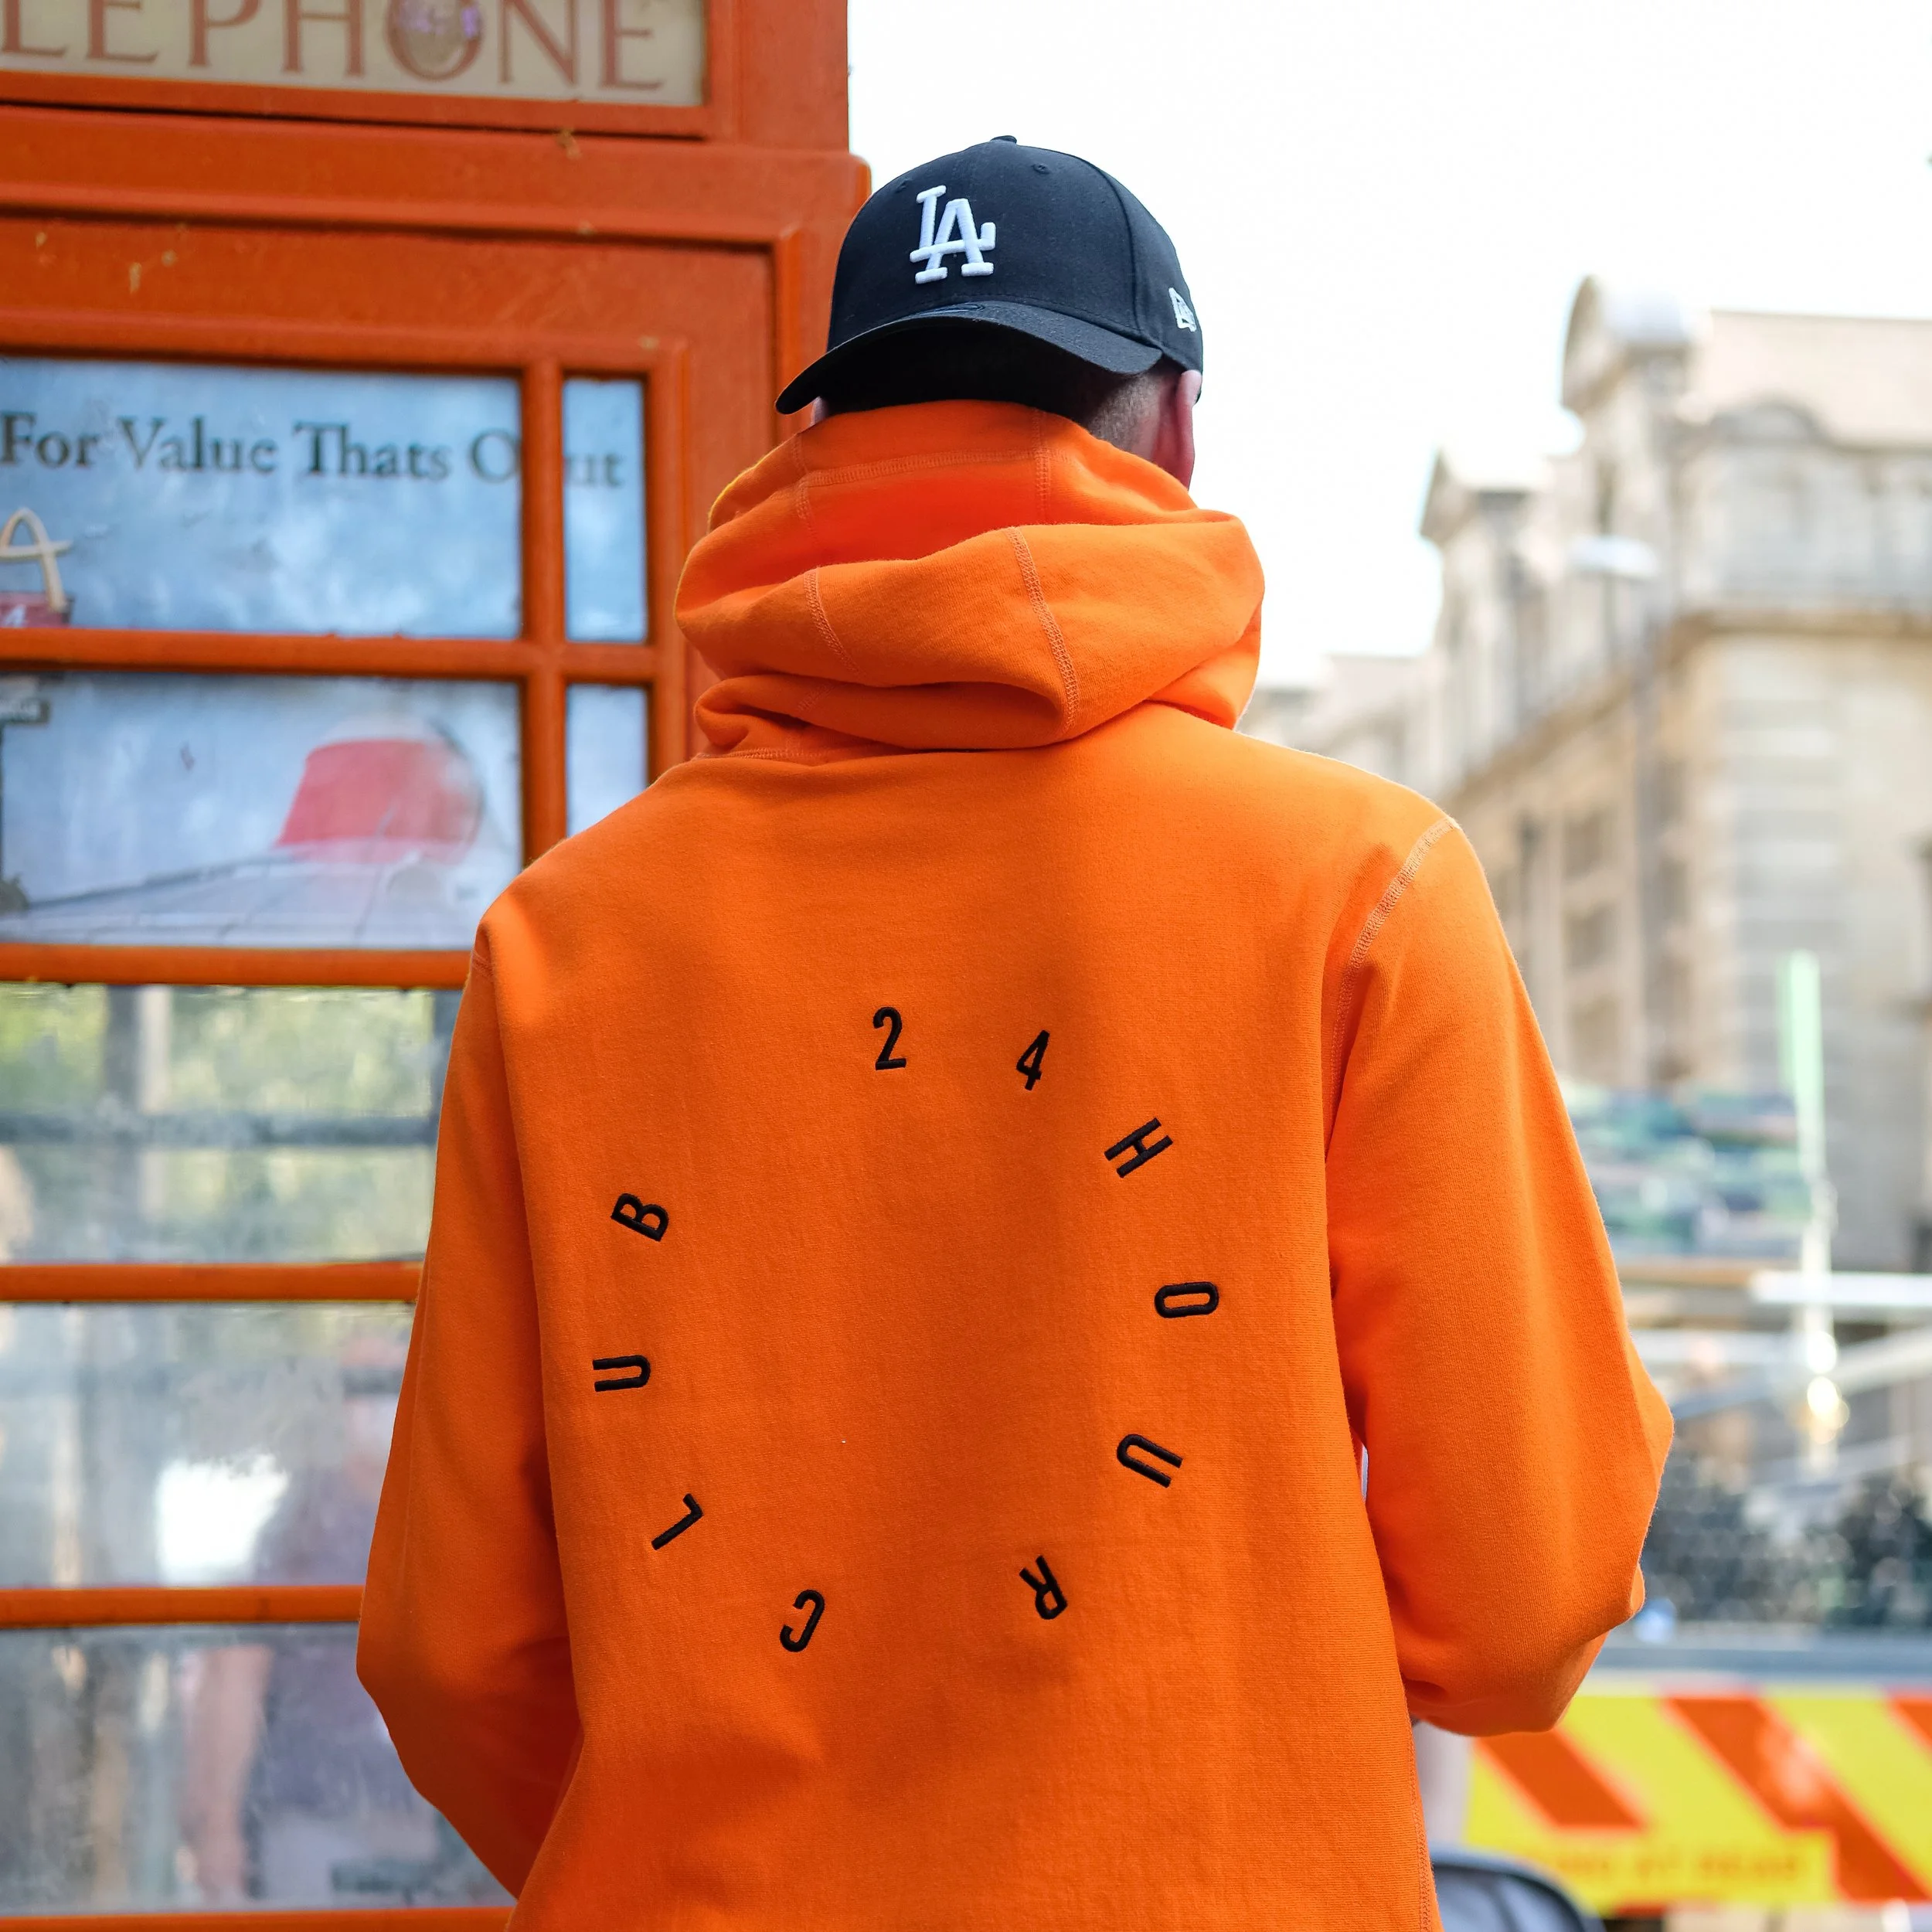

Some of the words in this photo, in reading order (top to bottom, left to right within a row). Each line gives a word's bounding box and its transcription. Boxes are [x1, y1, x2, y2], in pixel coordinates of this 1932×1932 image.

[910, 185, 996, 284] LA
[1, 411, 99, 468] For
[118, 415, 278, 473] Value
[293, 421, 452, 481] Thats
[872, 1006, 1050, 1090] 24
